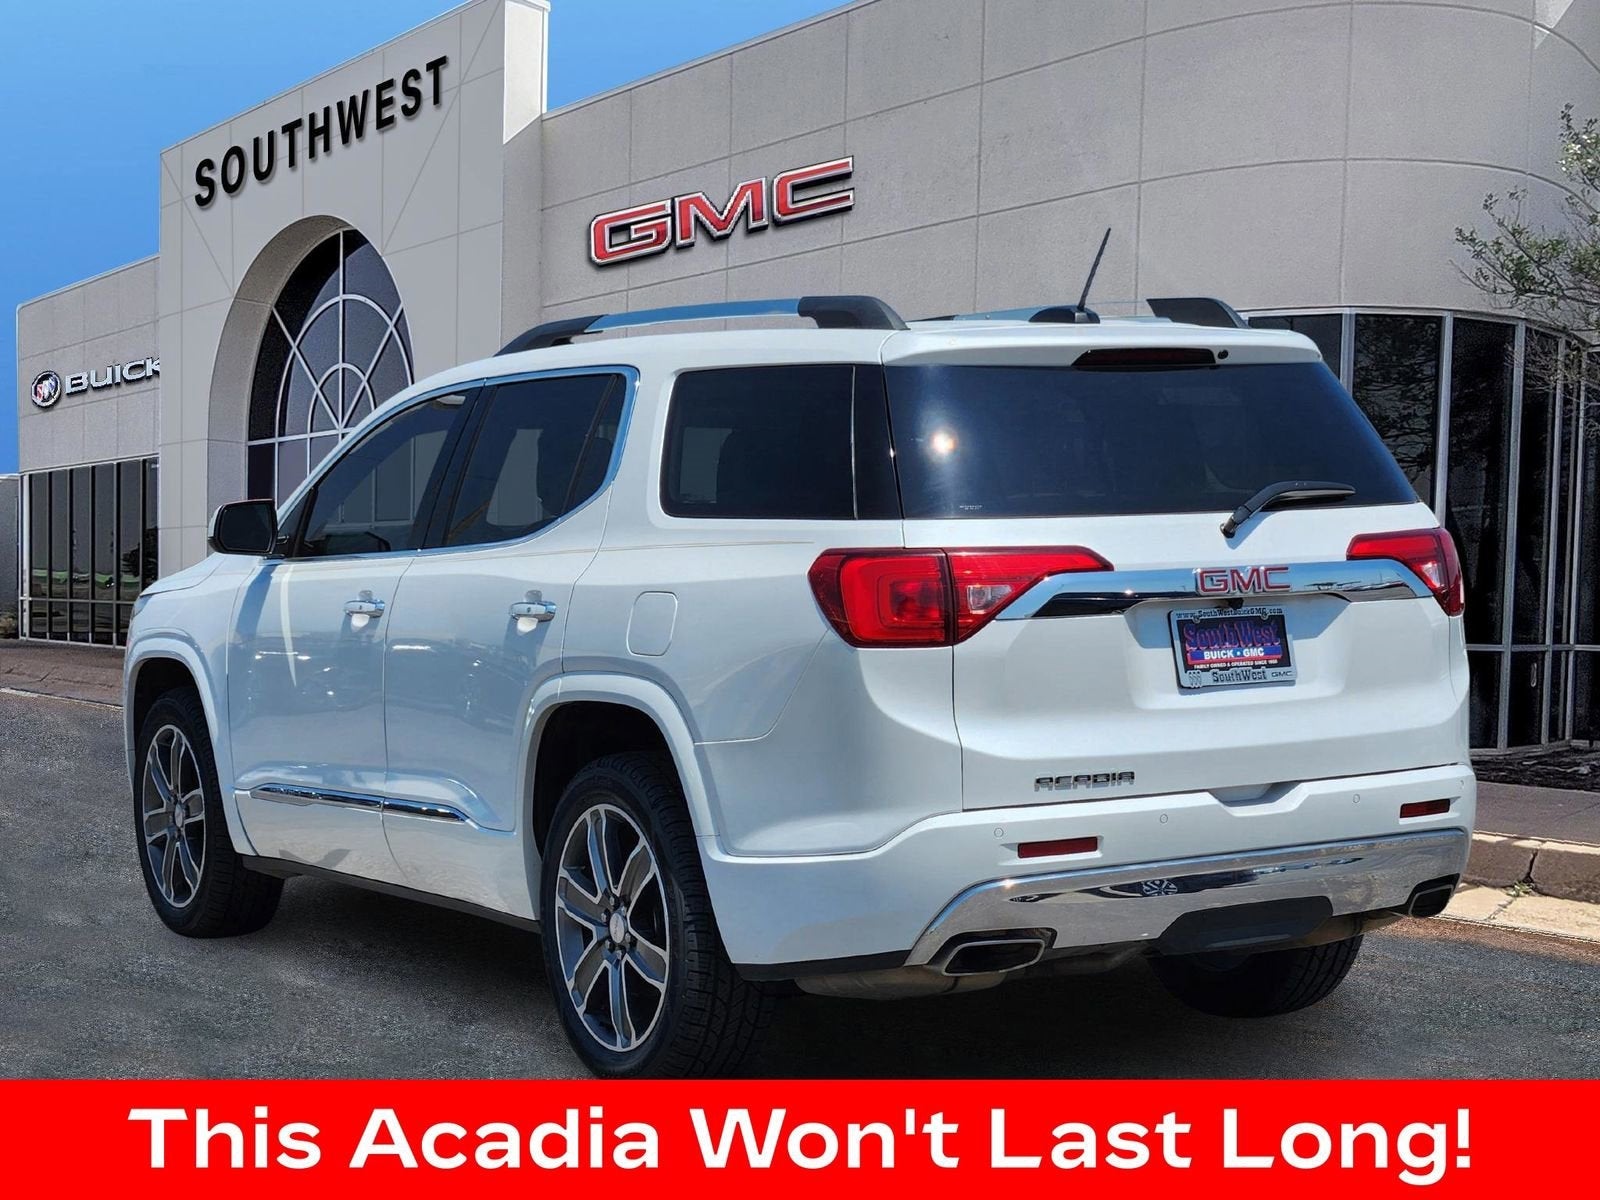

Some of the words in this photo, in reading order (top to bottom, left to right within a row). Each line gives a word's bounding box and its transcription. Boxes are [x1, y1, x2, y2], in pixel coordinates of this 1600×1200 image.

[194, 56, 449, 207] SOUTHWEST
[589, 156, 855, 266] GMC
[1196, 566, 1292, 595] GMC
[1184, 621, 1281, 650] SouthWest
[1204, 650, 1234, 660] BUICK
[1243, 647, 1265, 657] GMC
[1212, 668, 1268, 683] SouthWest
[1271, 670, 1293, 678] GMC
[1035, 771, 1135, 791] ACADIA
